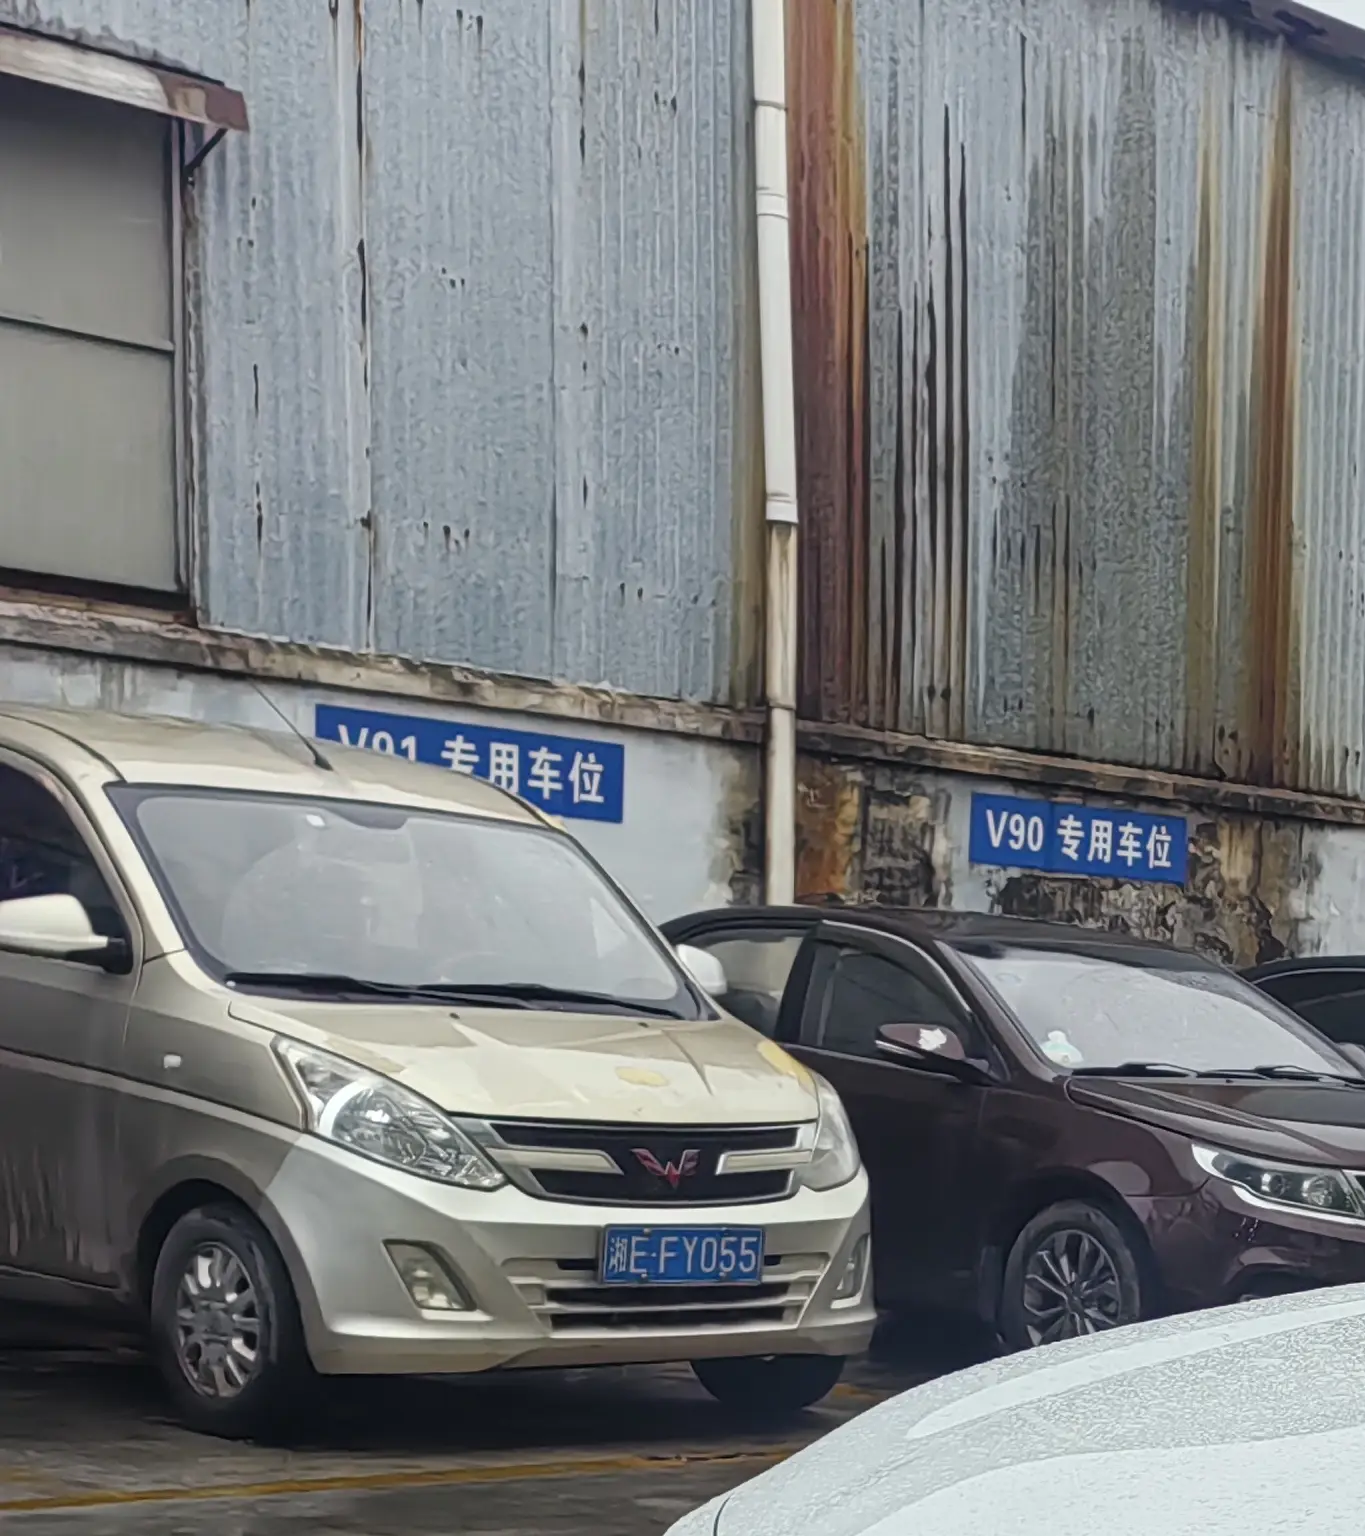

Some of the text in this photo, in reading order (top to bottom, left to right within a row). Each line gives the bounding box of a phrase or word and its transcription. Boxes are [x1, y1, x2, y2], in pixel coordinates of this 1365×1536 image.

[440, 735, 604, 804] 专用车位
[985, 809, 1173, 869] V90 专用车位
